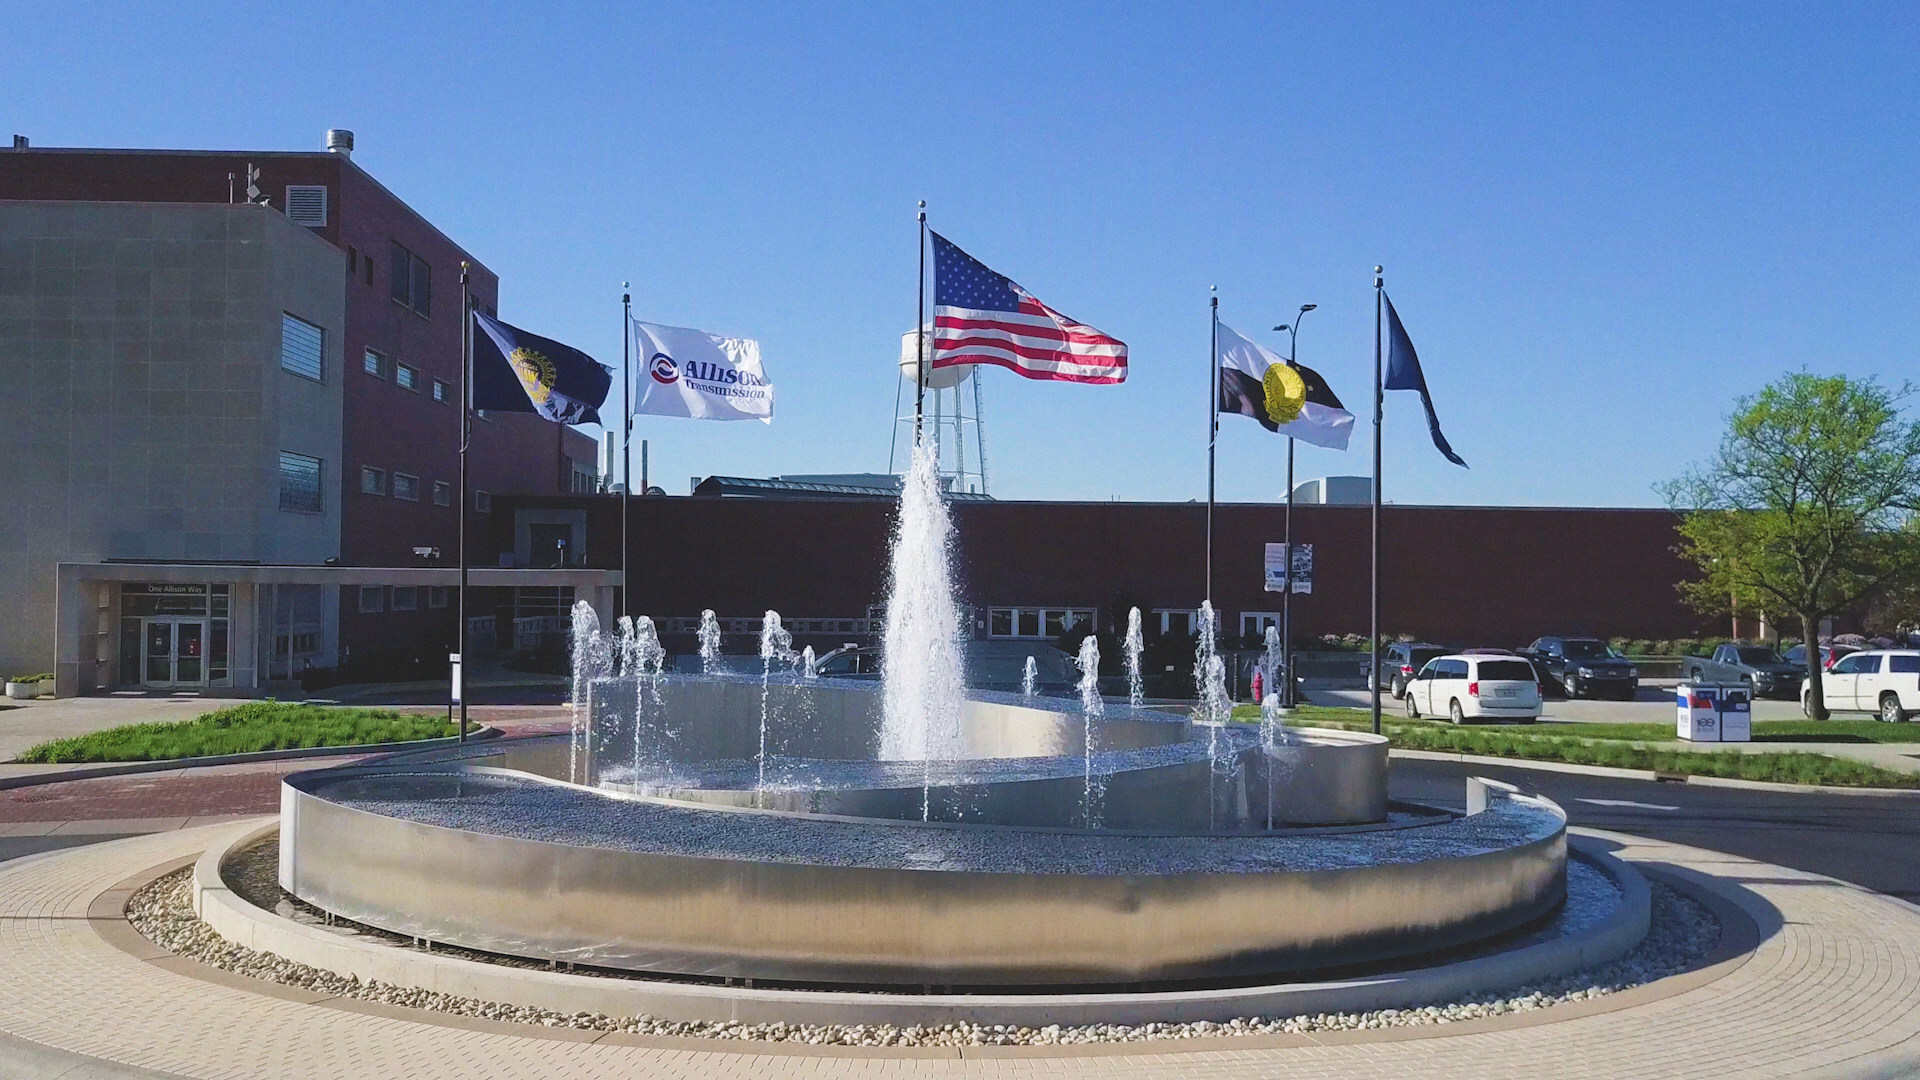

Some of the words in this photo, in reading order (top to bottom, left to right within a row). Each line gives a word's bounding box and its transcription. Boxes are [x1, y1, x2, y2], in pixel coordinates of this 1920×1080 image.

[683, 360, 765, 387] Allison
[683, 378, 766, 398] Transmission
[148, 585, 163, 593] One
[164, 585, 187, 593] Allison
[187, 586, 203, 594] Way
